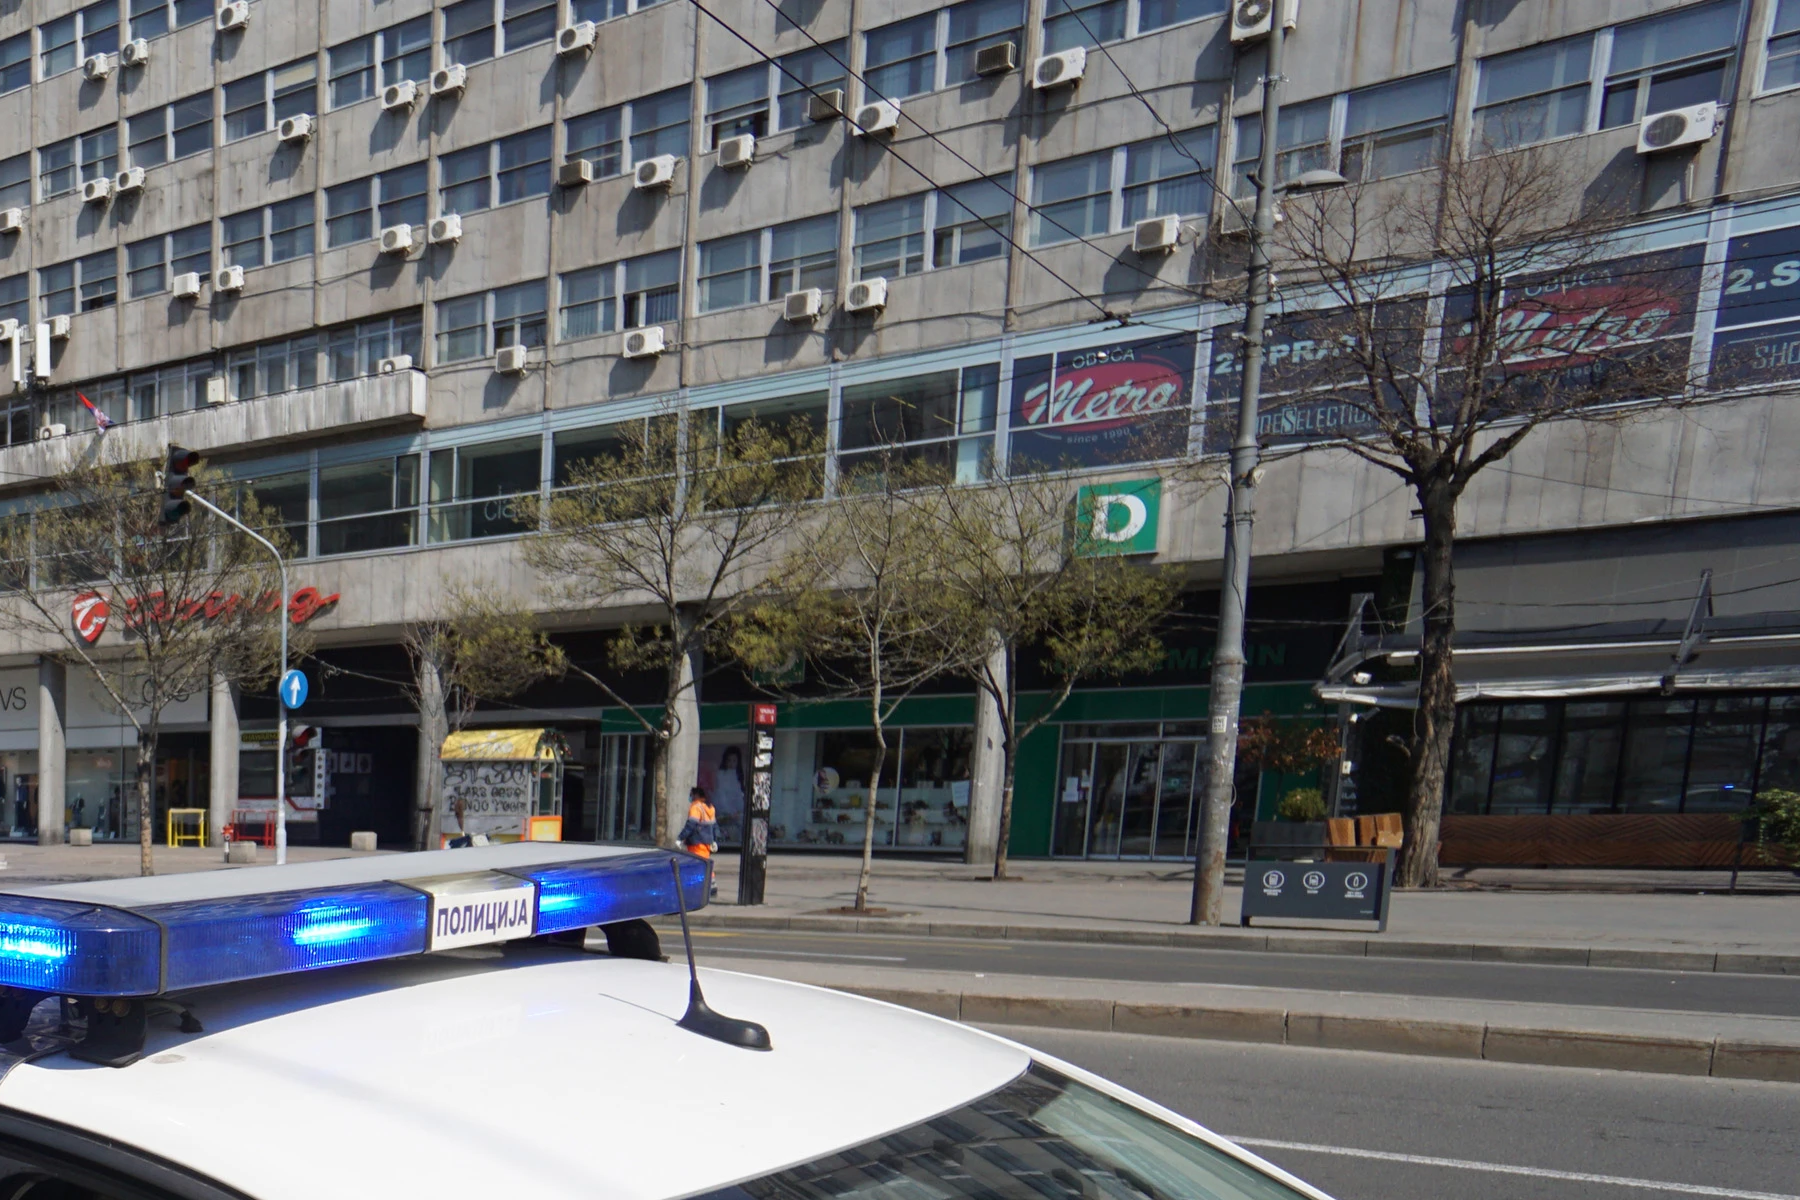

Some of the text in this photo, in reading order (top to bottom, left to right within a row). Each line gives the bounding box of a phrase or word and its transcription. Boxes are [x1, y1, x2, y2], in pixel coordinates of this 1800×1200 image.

[1023, 377, 1178, 425] Metro
[1066, 427, 1131, 444] since 1990
[1090, 493, 1147, 543] D
[436, 898, 528, 937] ПОЛИЦИЈА
